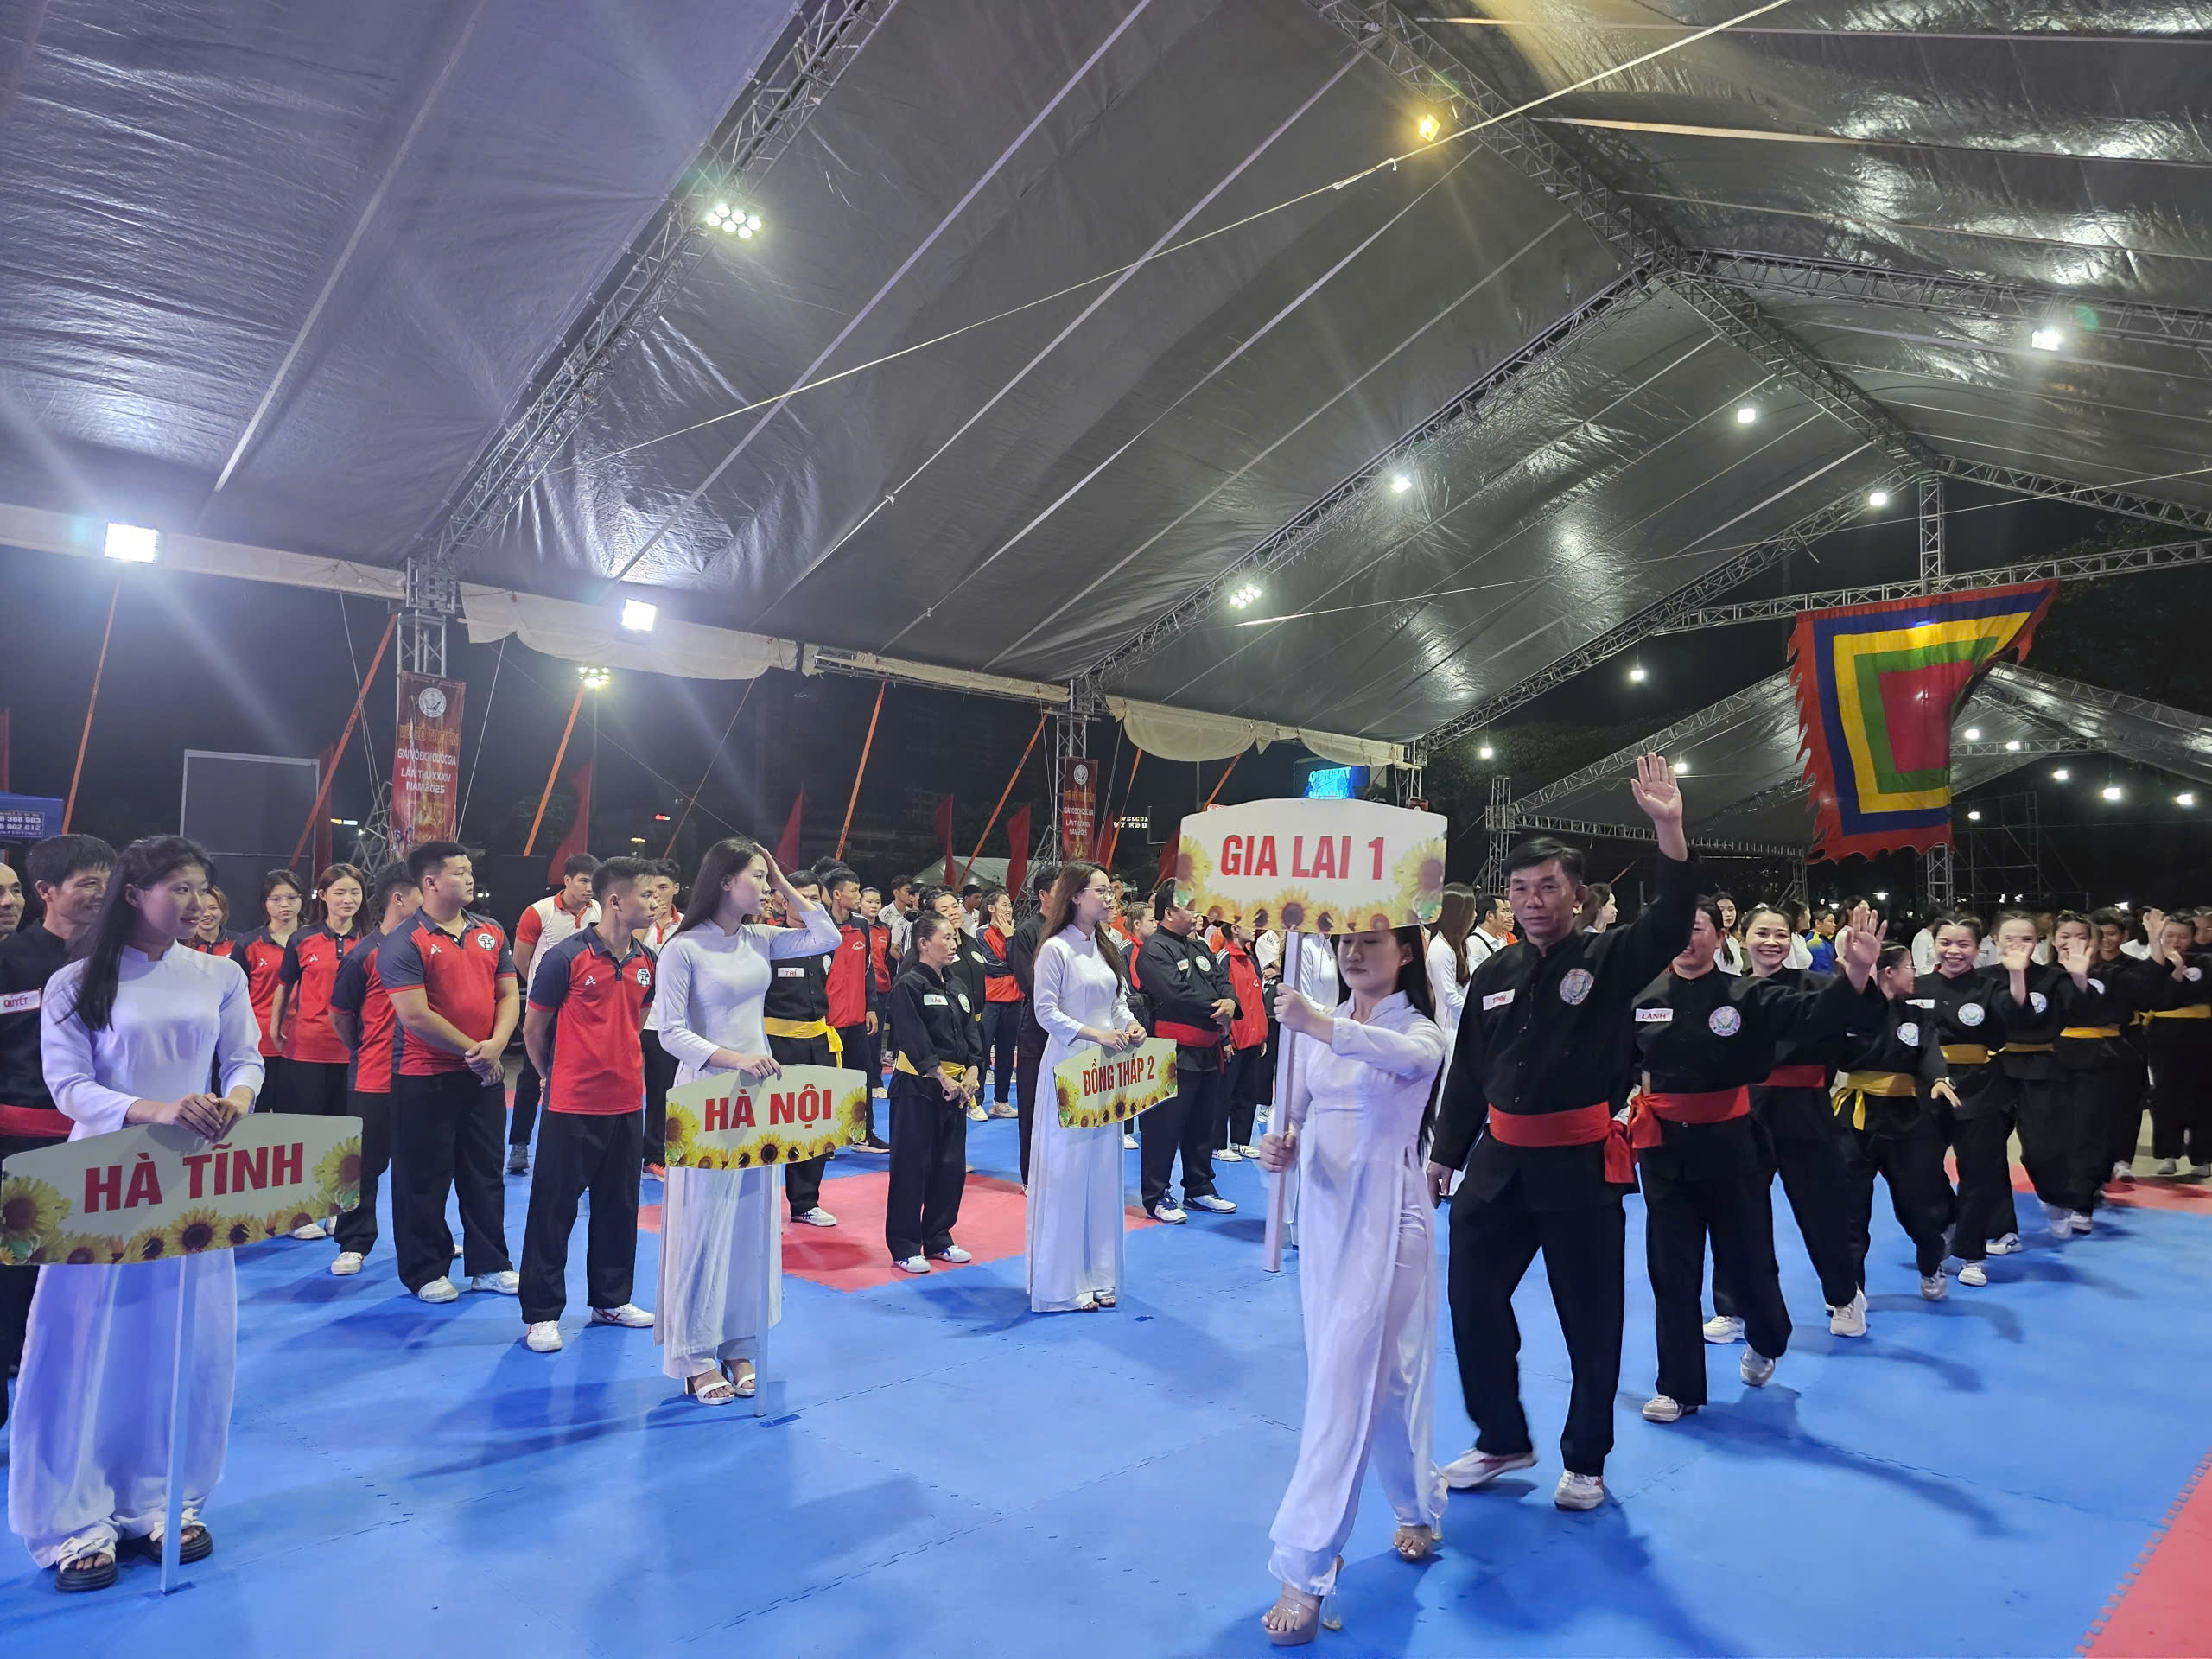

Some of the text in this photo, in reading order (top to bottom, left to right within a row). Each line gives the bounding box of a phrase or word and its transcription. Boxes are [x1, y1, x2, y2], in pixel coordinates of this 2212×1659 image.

[425, 783, 445, 794] 2025
[1220, 835, 1384, 880] GIA LAI 1
[1083, 1053, 1154, 1096] ĐỒNG THÁP 2
[705, 1084, 832, 1132] HÀ NỘI
[84, 1141, 303, 1214] HÀ TĨNH
